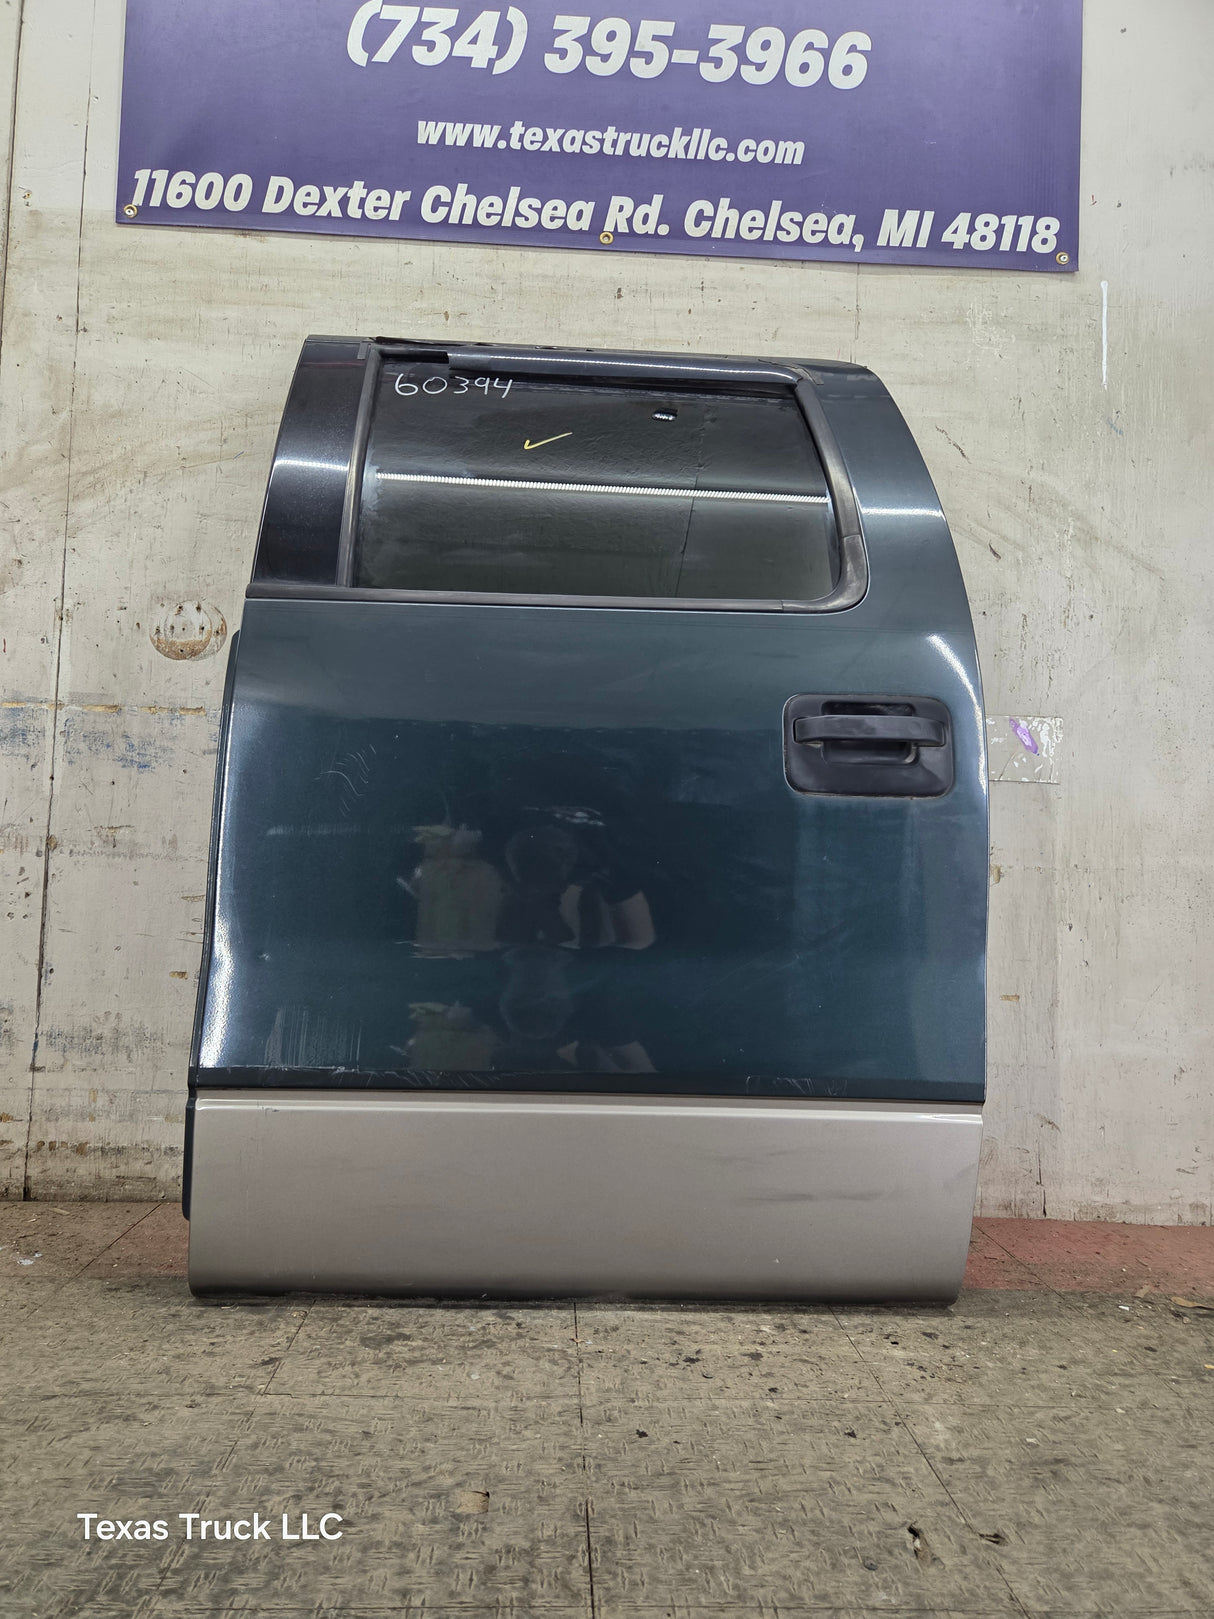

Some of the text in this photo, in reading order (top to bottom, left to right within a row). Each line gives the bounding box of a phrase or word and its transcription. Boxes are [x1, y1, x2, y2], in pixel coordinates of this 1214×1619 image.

[346, 0, 872, 90] (734) 395-3966
[416, 120, 805, 165] www.texastruckllc.com
[133, 169, 1061, 254] 11600 Dexter Chelsea Rd. Chelsea, MI 48118
[395, 373, 512, 398] 60394
